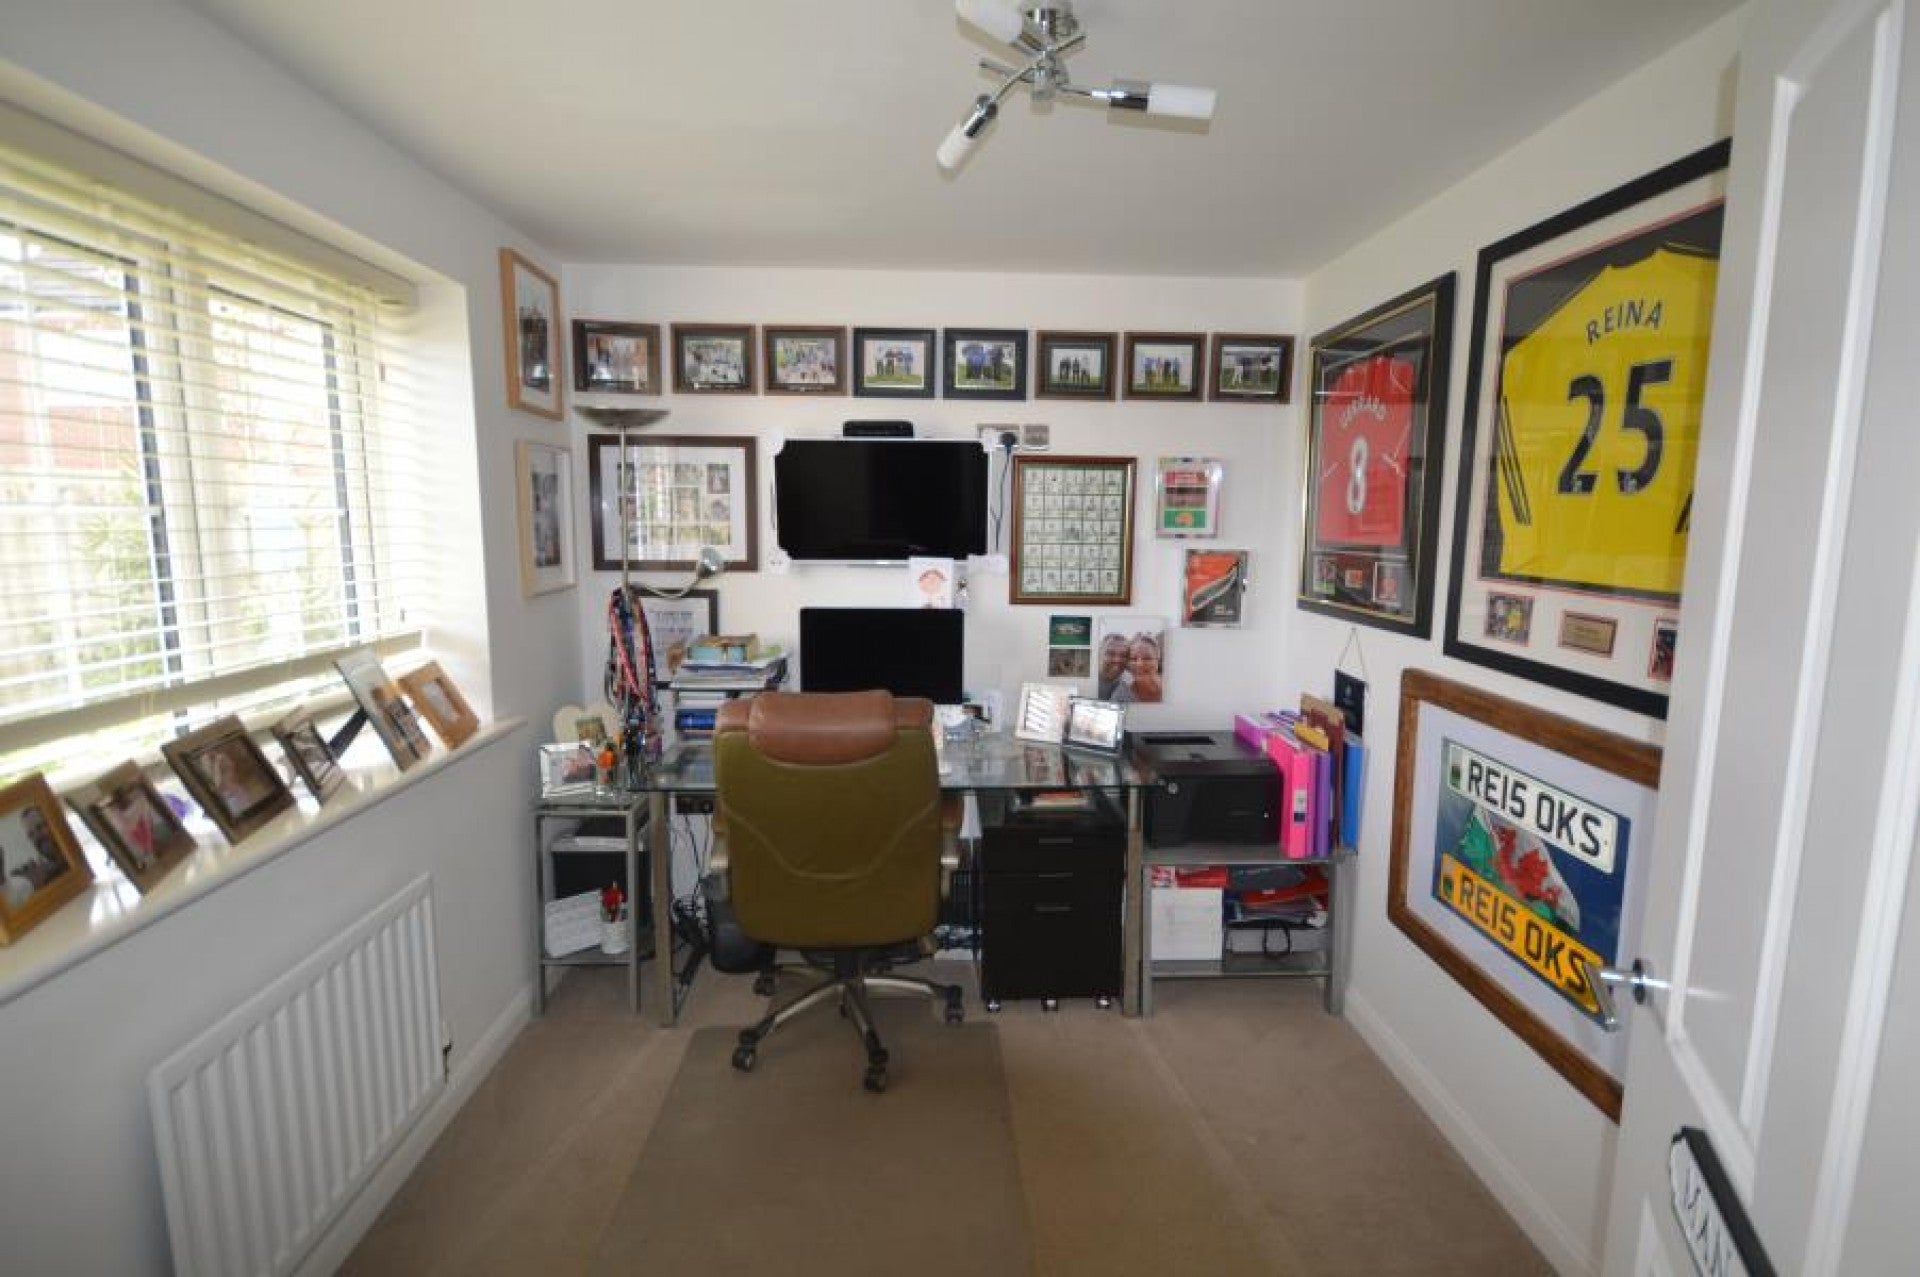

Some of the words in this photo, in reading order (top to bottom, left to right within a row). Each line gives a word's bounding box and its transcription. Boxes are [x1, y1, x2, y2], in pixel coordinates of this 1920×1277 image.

[1586, 297, 1663, 345] REINA
[1558, 359, 1674, 494] 25
[1346, 435, 1368, 514] 8
[1535, 791, 1601, 857] OKS
[1524, 918, 1587, 994] OKS
